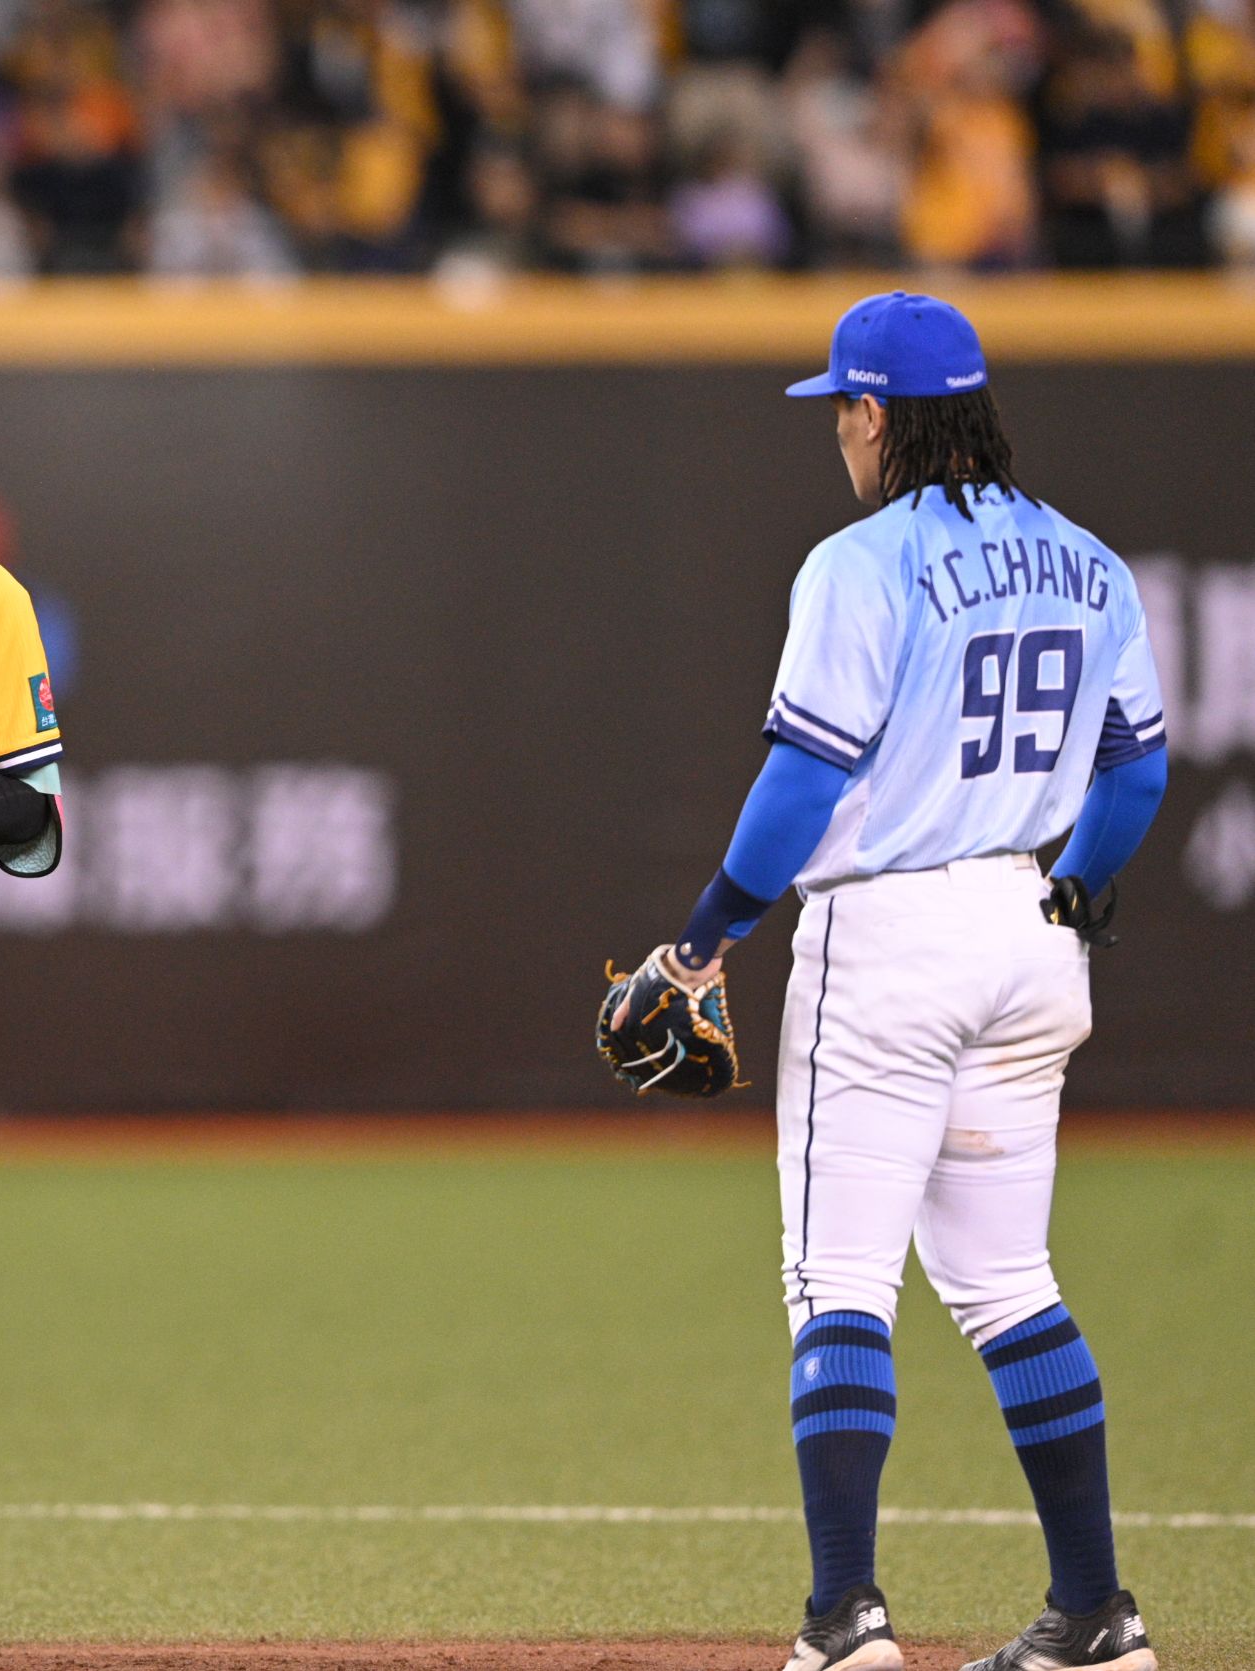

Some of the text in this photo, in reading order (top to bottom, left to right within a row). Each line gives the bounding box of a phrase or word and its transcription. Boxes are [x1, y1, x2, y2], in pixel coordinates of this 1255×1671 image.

[847, 367, 888, 386] momo
[917, 537, 1109, 623] Y.C.CHANG
[959, 625, 1084, 780] 99
